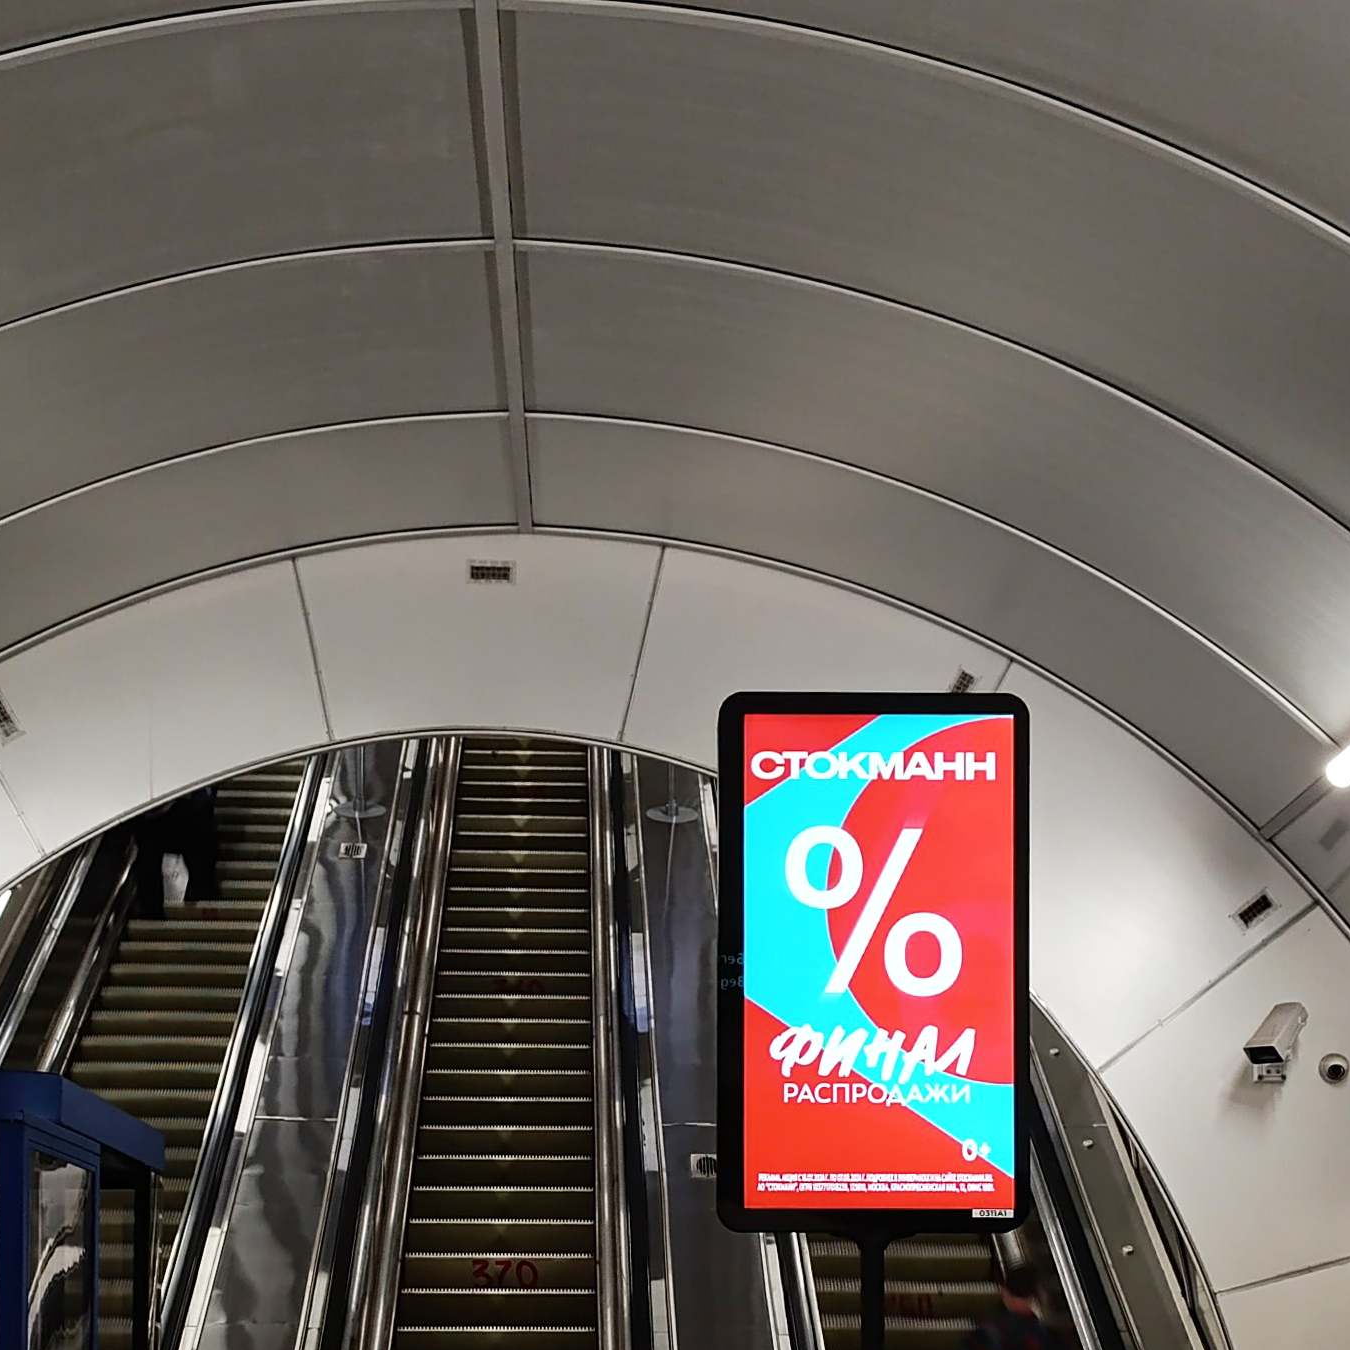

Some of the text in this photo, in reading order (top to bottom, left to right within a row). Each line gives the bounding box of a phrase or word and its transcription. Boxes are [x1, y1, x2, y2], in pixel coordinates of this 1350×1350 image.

[751, 750, 996, 781] СТОКМАНН
[768, 1023, 977, 1084] ФИНАЛ
[782, 1081, 971, 1107] РАСПРОДАЖИ
[961, 1139, 992, 1162] 0+
[472, 1259, 539, 1288] 370
